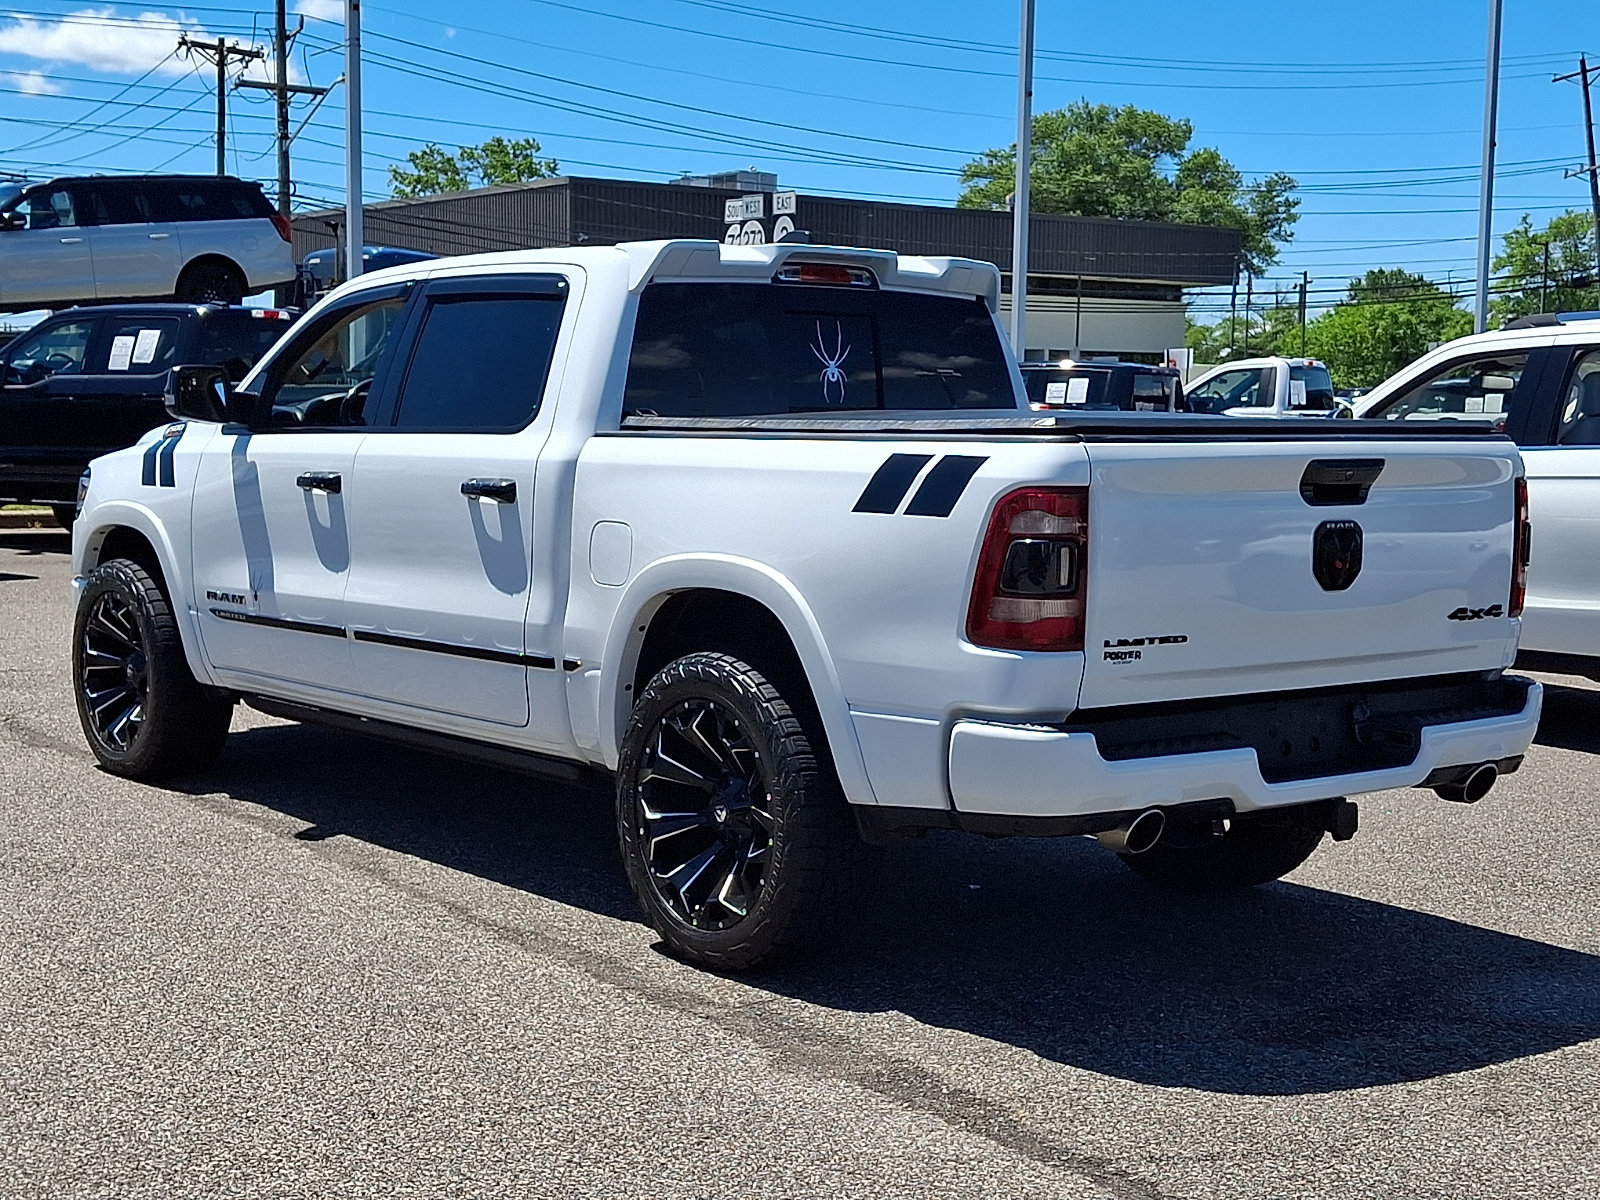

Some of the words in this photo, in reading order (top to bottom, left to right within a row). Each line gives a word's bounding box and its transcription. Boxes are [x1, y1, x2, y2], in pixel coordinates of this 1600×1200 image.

[745, 200, 760, 214] WEST
[776, 196, 792, 211] EAST
[726, 205, 743, 218] SOUT
[206, 590, 247, 605] RAM
[1103, 635, 1188, 648] LIMITED
[1103, 650, 1142, 661] PORTER
